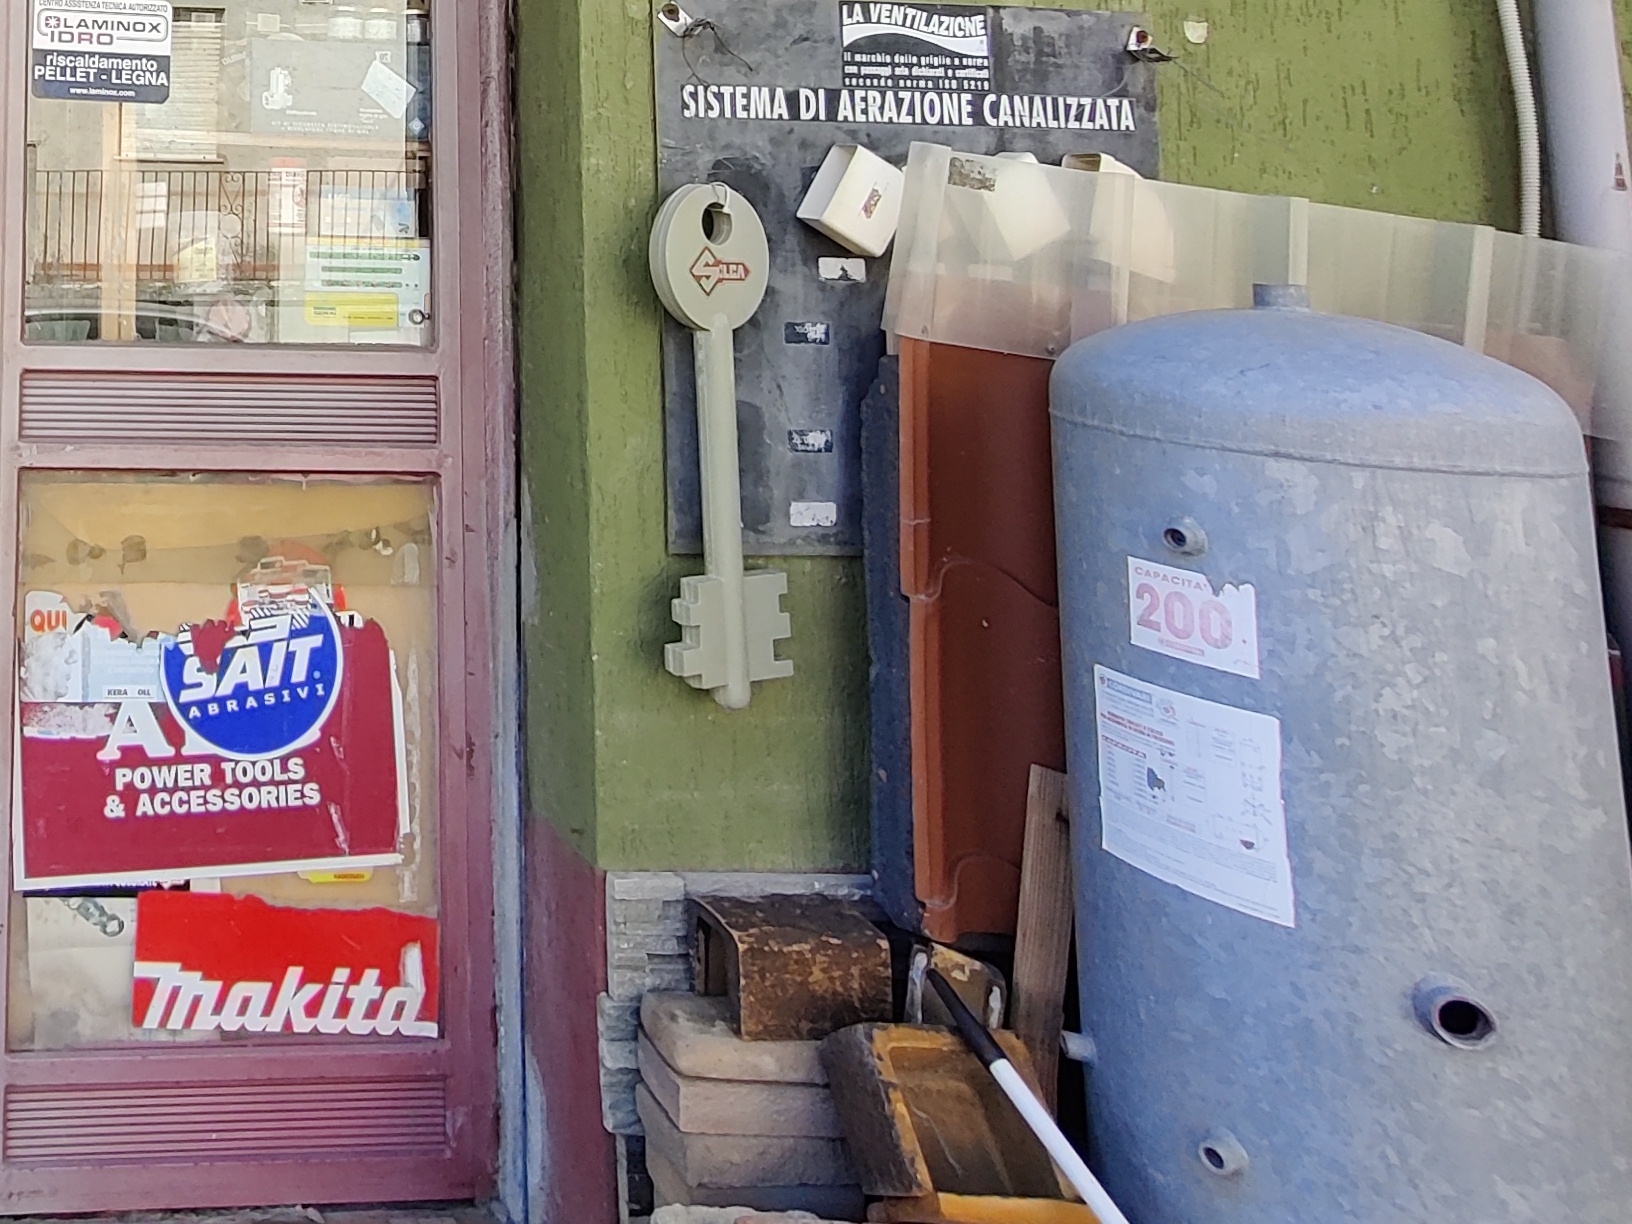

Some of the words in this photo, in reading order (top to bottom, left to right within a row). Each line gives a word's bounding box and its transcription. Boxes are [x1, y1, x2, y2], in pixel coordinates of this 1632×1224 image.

[64, 0, 101, 9] ASSISTENZA
[101, 1, 127, 10] TECNICA
[128, 2, 168, 13] AUTORIZZATO
[842, 3, 865, 26] LA
[869, 2, 987, 37] VENTILAZIONE
[50, 30, 114, 46] IDRO
[63, 17, 162, 34] LAMINOX
[34, 65, 98, 83] PELLET
[110, 69, 169, 87] LEGNA
[46, 52, 158, 71] riscaldamento
[68, 87, 136, 97] www.laminox.com
[682, 84, 789, 121] SISTEMA
[798, 87, 826, 122] DI
[837, 89, 973, 126] AERAZIONE
[983, 93, 1137, 132] CANALIZZATA
[1135, 582, 1233, 650] 200
[180, 633, 325, 703] SAIT
[187, 683, 327, 721] ABRASIVI
[113, 763, 211, 791] POWER
[224, 756, 306, 784] TOOLS
[103, 794, 126, 819] &
[136, 781, 321, 817] ACCESSORIES
